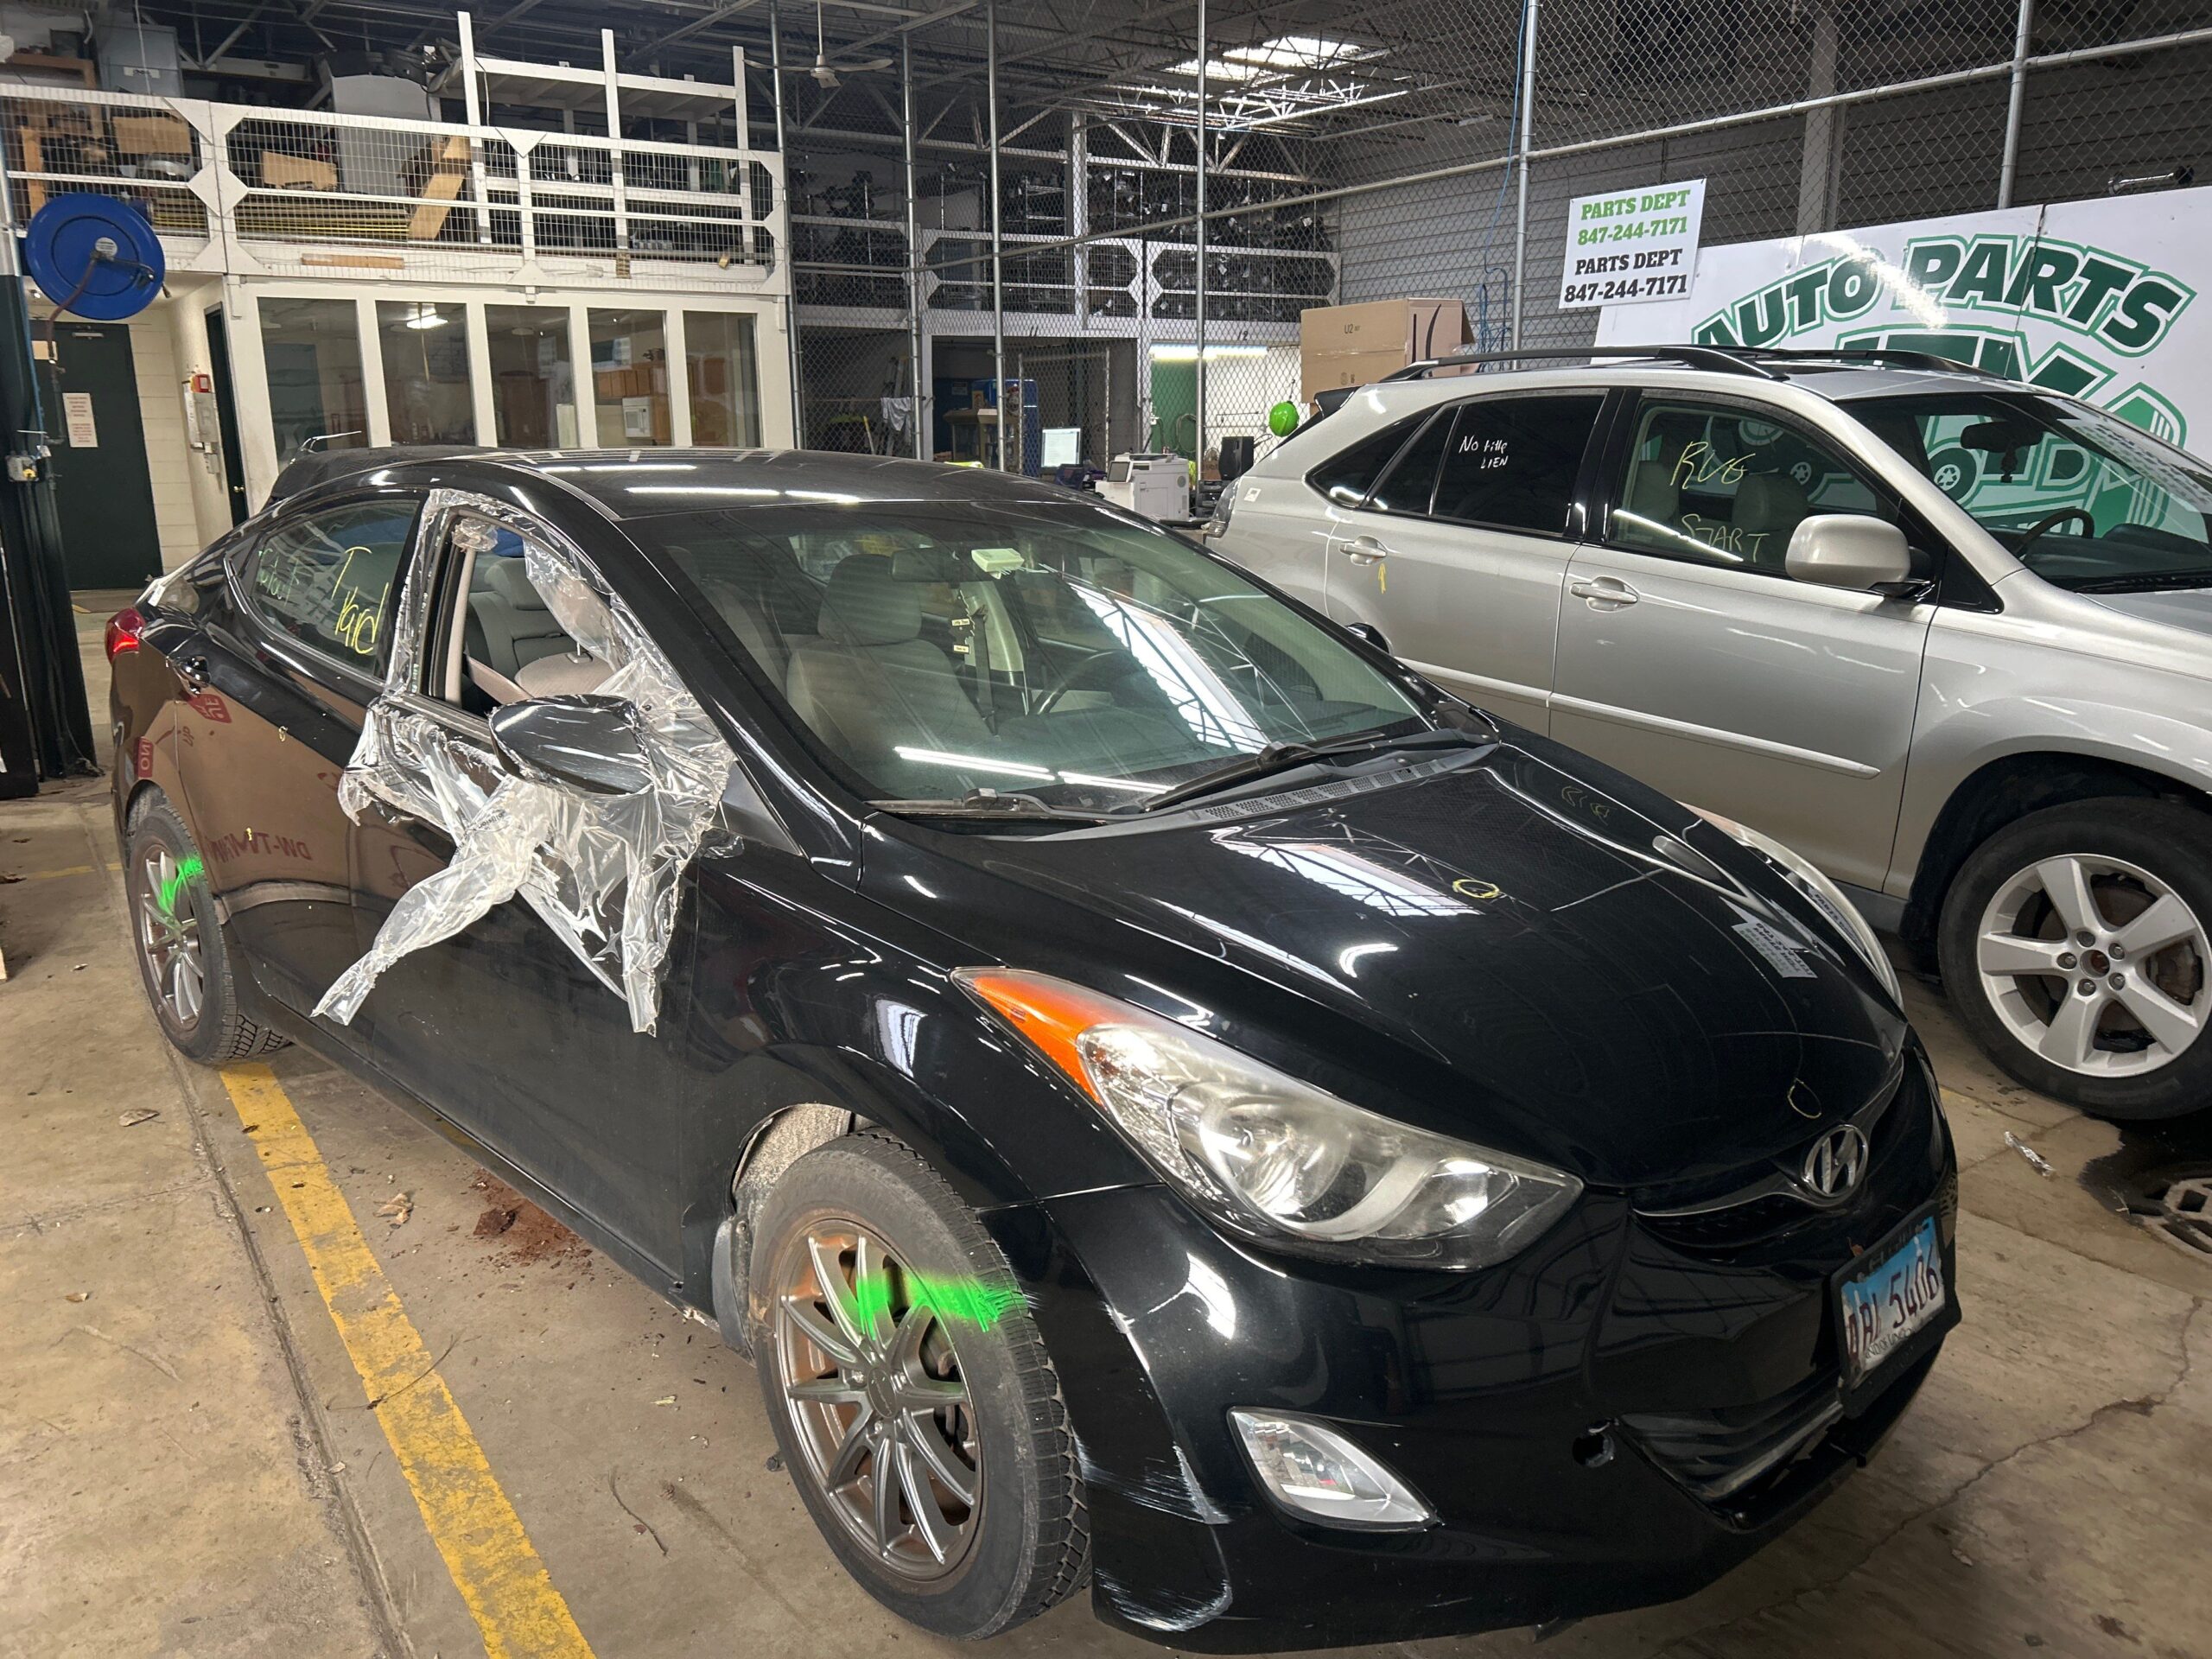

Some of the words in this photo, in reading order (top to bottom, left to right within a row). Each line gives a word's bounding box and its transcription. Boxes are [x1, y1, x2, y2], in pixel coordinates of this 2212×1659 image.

[1580, 198, 1637, 220] PARTS
[1640, 189, 1691, 213] DEPT
[1577, 216, 1688, 245] 847-244-7171
[1574, 254, 1630, 276] PARTS
[1633, 248, 1683, 270] DEPT
[1564, 274, 1688, 303] 847-244-7171
[1694, 253, 1882, 347] AUTO
[1898, 238, 2191, 352] PARTS
[1459, 435, 1478, 454] No
[1480, 455, 1509, 469] LIEN
